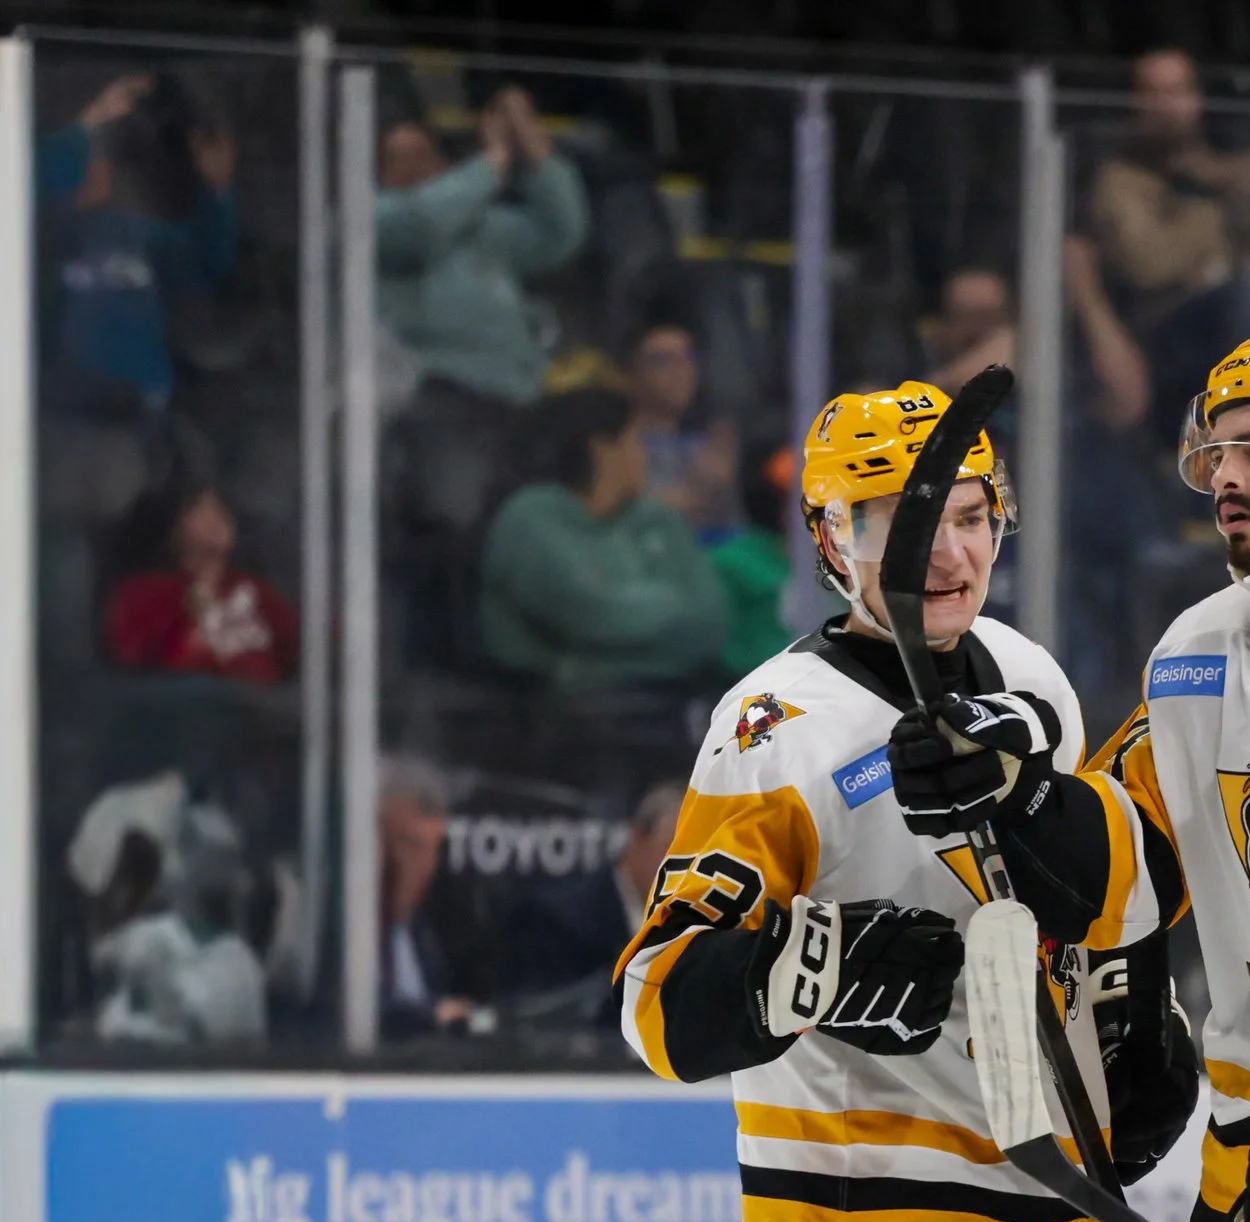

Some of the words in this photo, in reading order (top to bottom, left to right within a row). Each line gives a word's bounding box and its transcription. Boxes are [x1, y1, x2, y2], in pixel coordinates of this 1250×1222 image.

[1152, 664, 1223, 685] Geisinger
[842, 757, 893, 794] Geisin
[791, 898, 834, 1019] CCM
